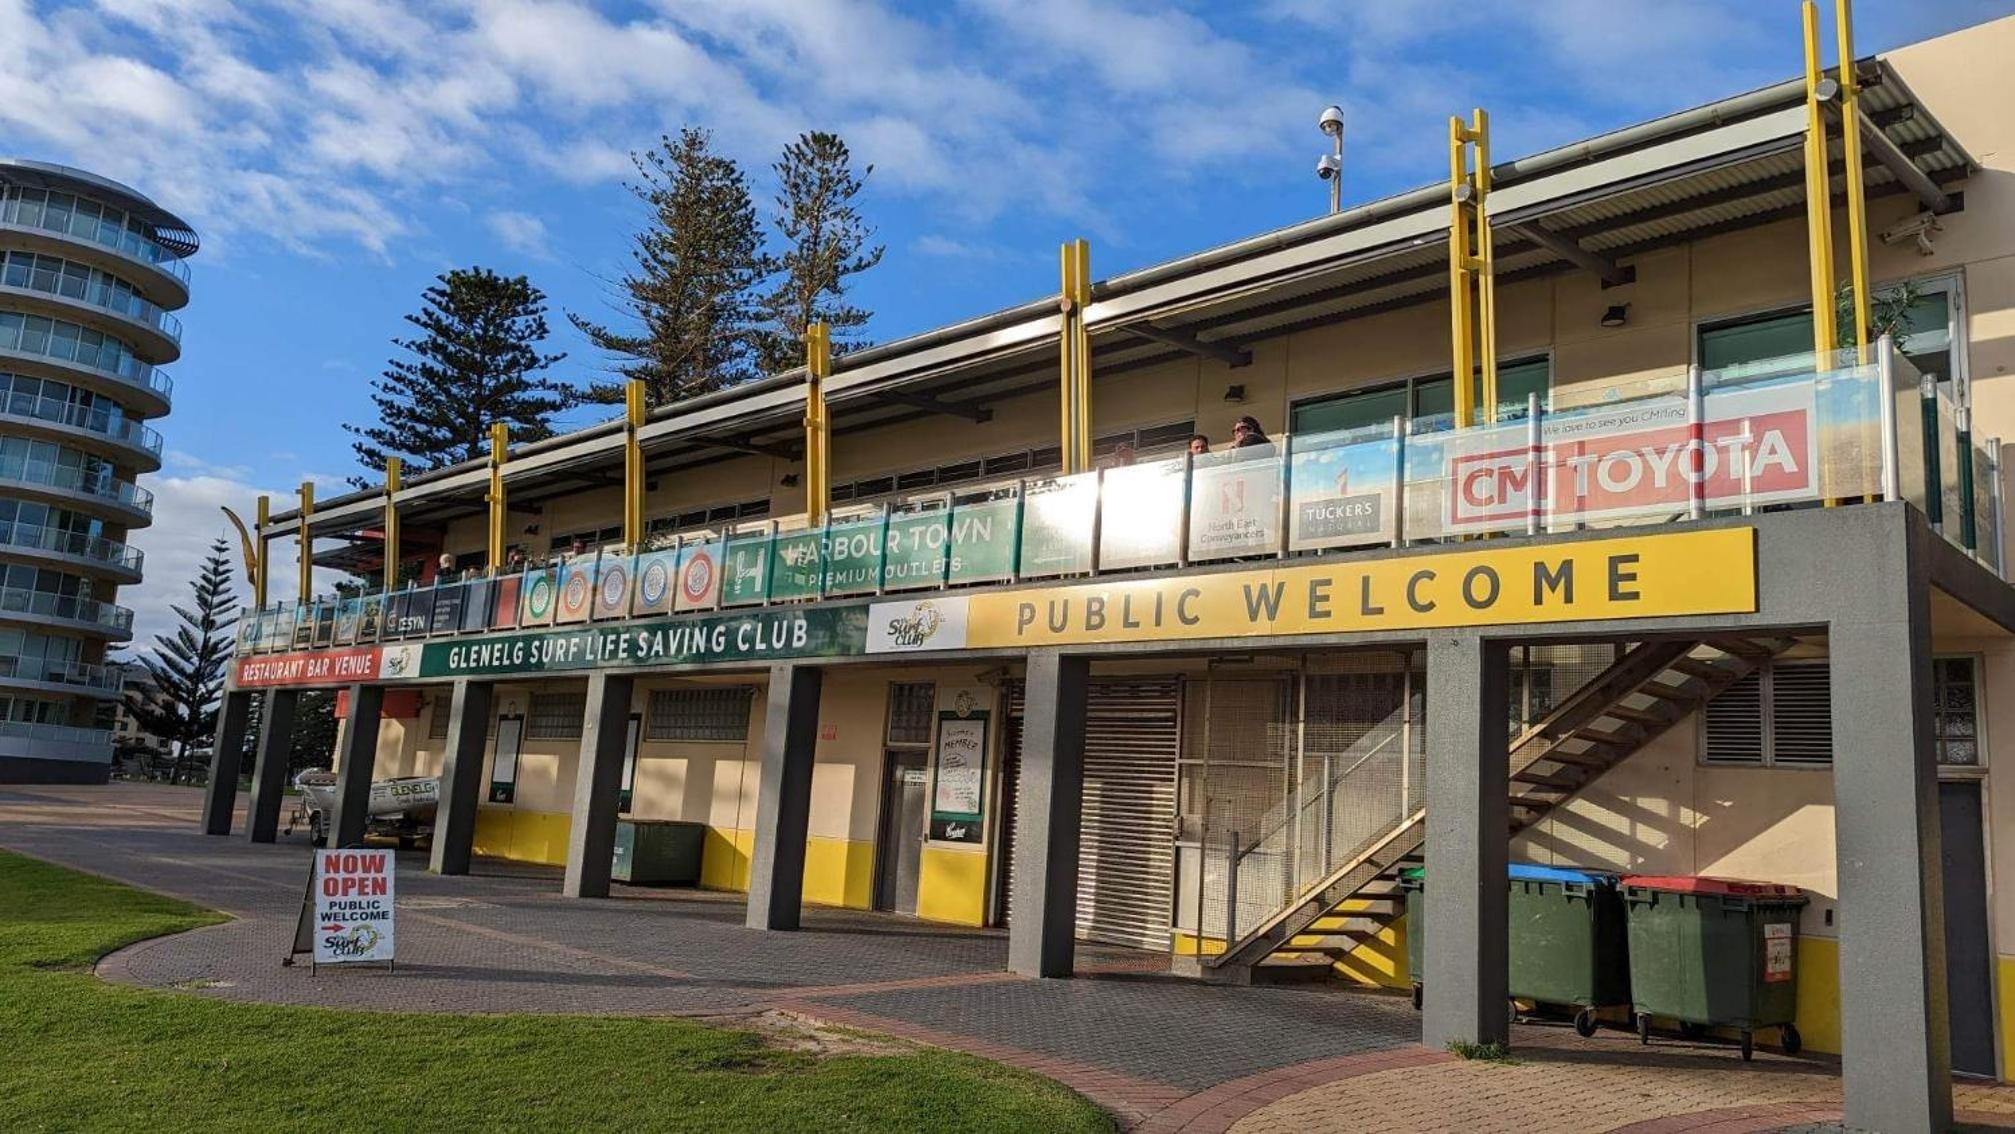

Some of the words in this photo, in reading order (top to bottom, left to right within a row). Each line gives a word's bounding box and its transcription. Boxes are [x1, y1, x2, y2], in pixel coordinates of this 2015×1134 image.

[1562, 422, 1583, 433] love
[1586, 421, 1596, 430] to
[1598, 418, 1617, 428] see
[1618, 415, 1639, 427] you
[1567, 429, 1799, 497] TOYOTA
[909, 516, 992, 551] TOWN
[1208, 518, 1234, 532] North
[1237, 517, 1258, 529] East
[1017, 588, 1200, 636] PUBLIC
[1242, 553, 1641, 623] WELCOME
[887, 615, 923, 636] Surf
[449, 640, 524, 669] GLENELG
[529, 637, 579, 664] SURF
[585, 632, 630, 661] LIFE
[637, 625, 726, 658] SAVING
[738, 618, 808, 651] CLUB
[242, 659, 304, 681] RESTAURANT
[307, 656, 329, 677] BAR
[335, 654, 372, 675] VENUE
[324, 854, 386, 874] NOW
[323, 877, 387, 897] OPEN
[329, 900, 381, 911] PUBLIC
[320, 911, 390, 922] WELCOME
